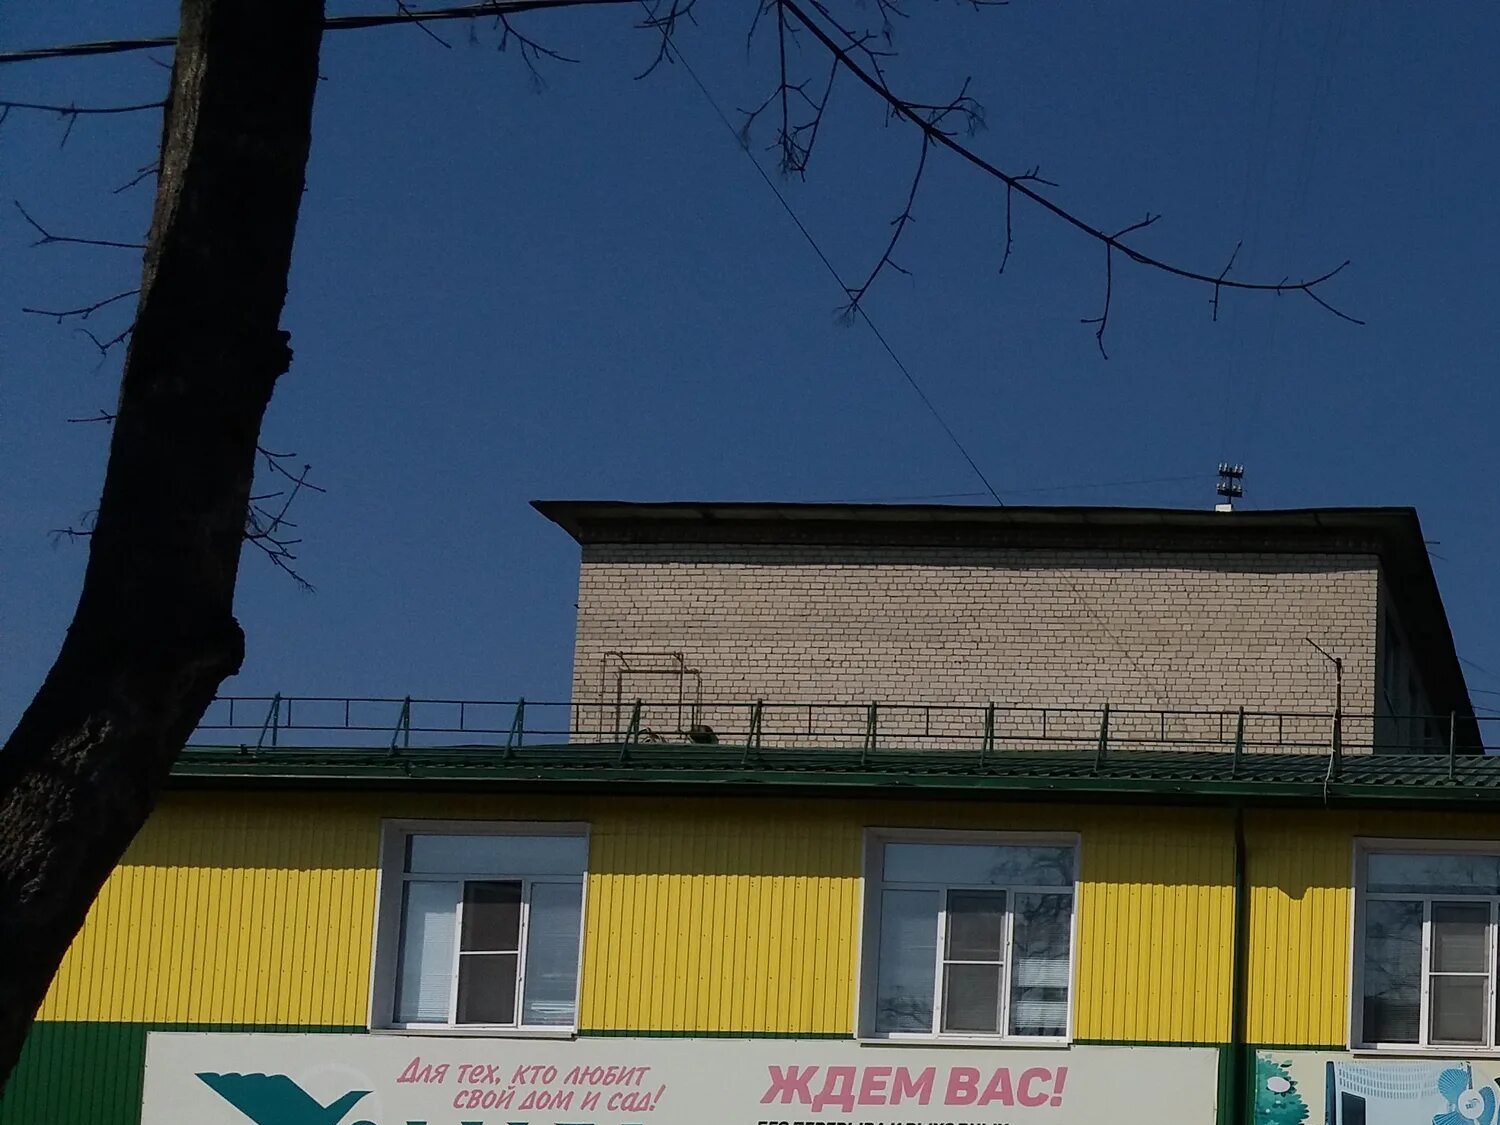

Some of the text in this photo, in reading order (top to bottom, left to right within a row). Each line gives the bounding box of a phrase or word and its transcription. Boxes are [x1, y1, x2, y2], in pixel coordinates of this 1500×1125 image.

[396, 1056, 651, 1086] Для тех, кто любит
[452, 1084, 667, 1112] свой дом и сад!
[760, 1065, 1069, 1113] ЖДЕМ ВАС!
